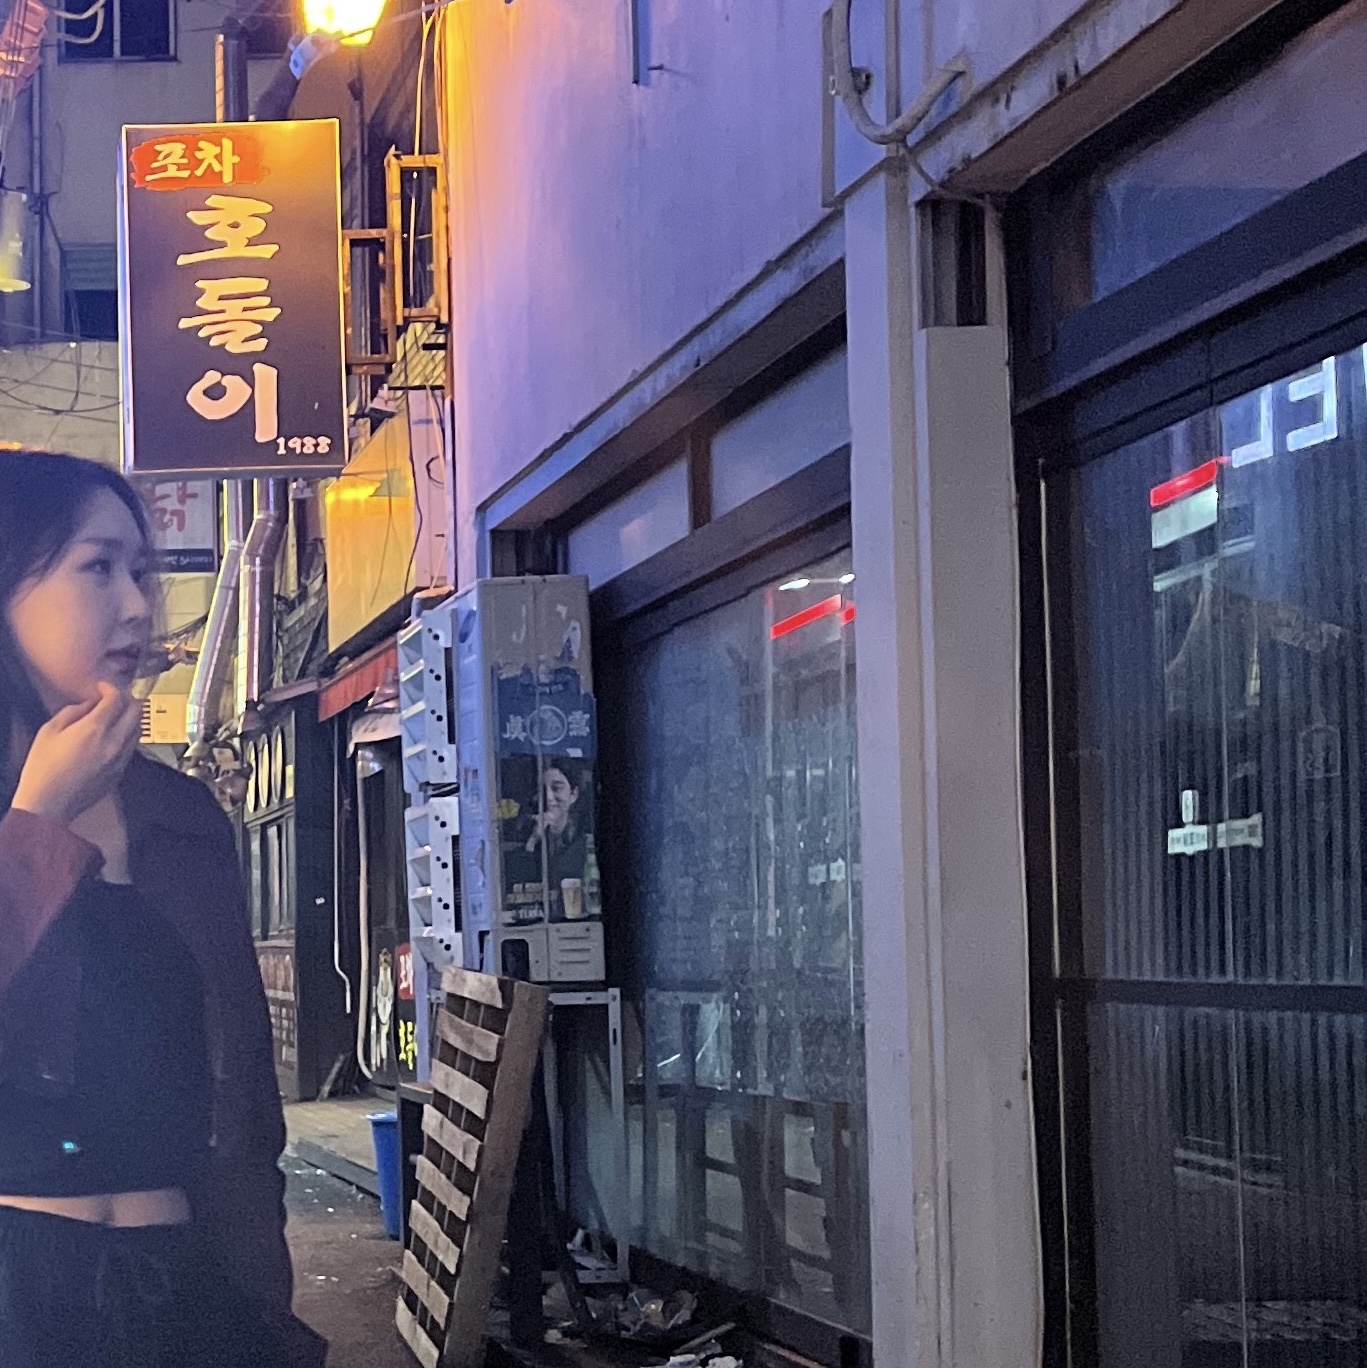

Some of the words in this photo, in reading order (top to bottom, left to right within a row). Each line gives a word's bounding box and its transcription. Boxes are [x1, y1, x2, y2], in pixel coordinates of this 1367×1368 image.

[145, 137, 240, 184] 포차
[177, 194, 282, 443] 호돌이
[276, 436, 331, 455] 1988
